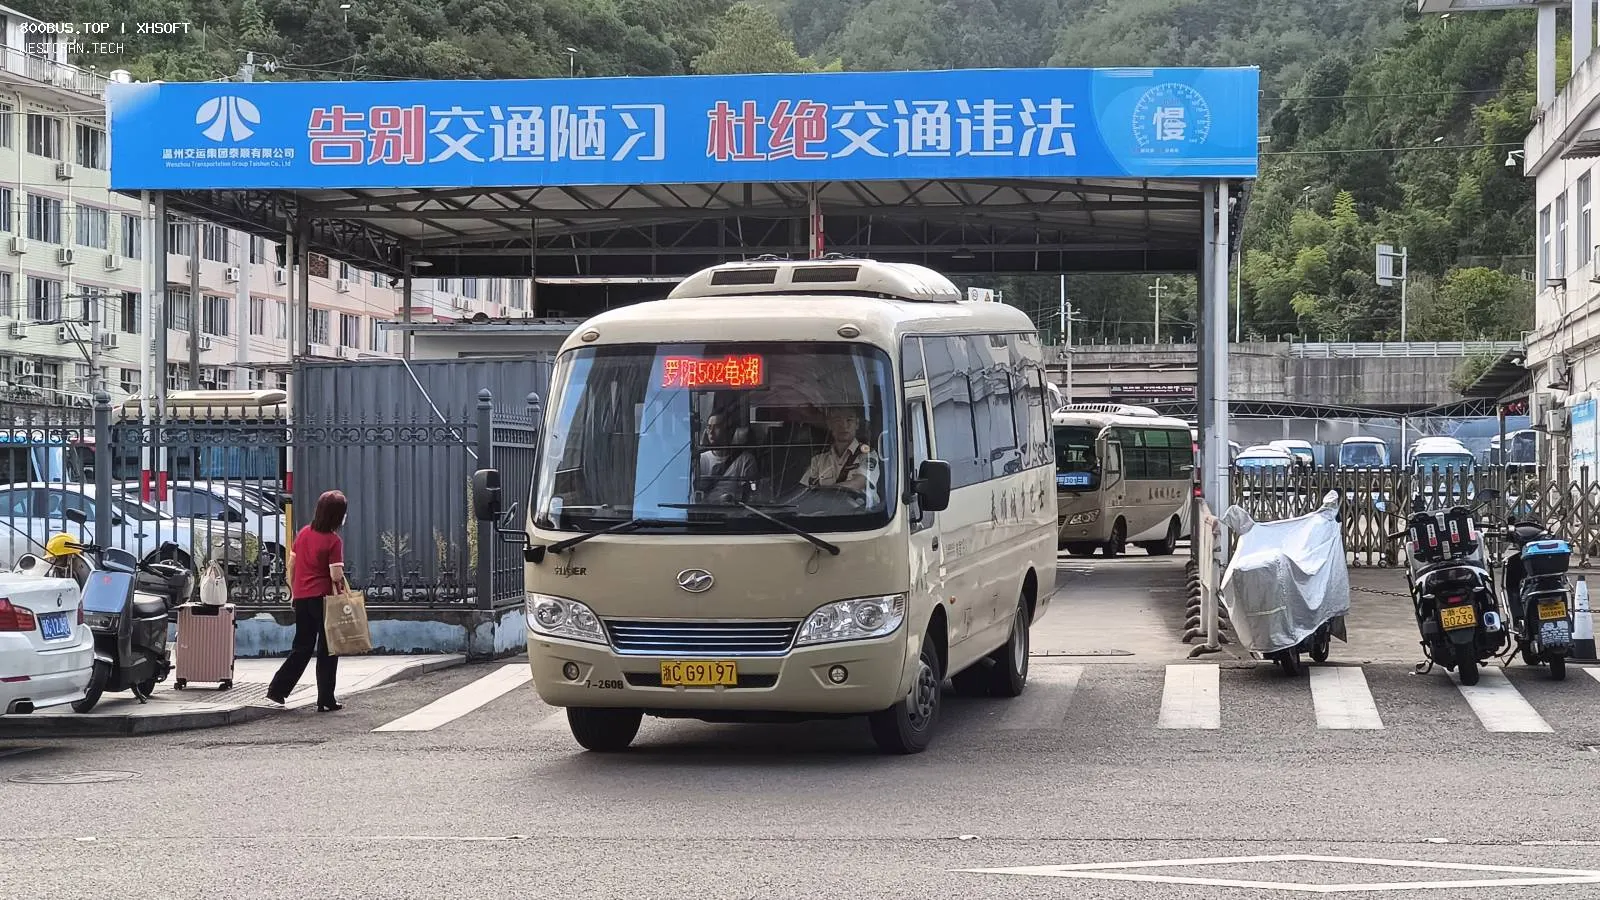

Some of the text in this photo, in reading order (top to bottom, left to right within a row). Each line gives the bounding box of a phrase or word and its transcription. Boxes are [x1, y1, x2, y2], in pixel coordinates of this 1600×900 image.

[307, 97, 1077, 166] 告别交通陋习 杜绝交通违法
[1152, 106, 1187, 141] 慢
[162, 147, 295, 160] 温州交运集团泰顺有限公司
[586, 679, 625, 690] 7-2608
